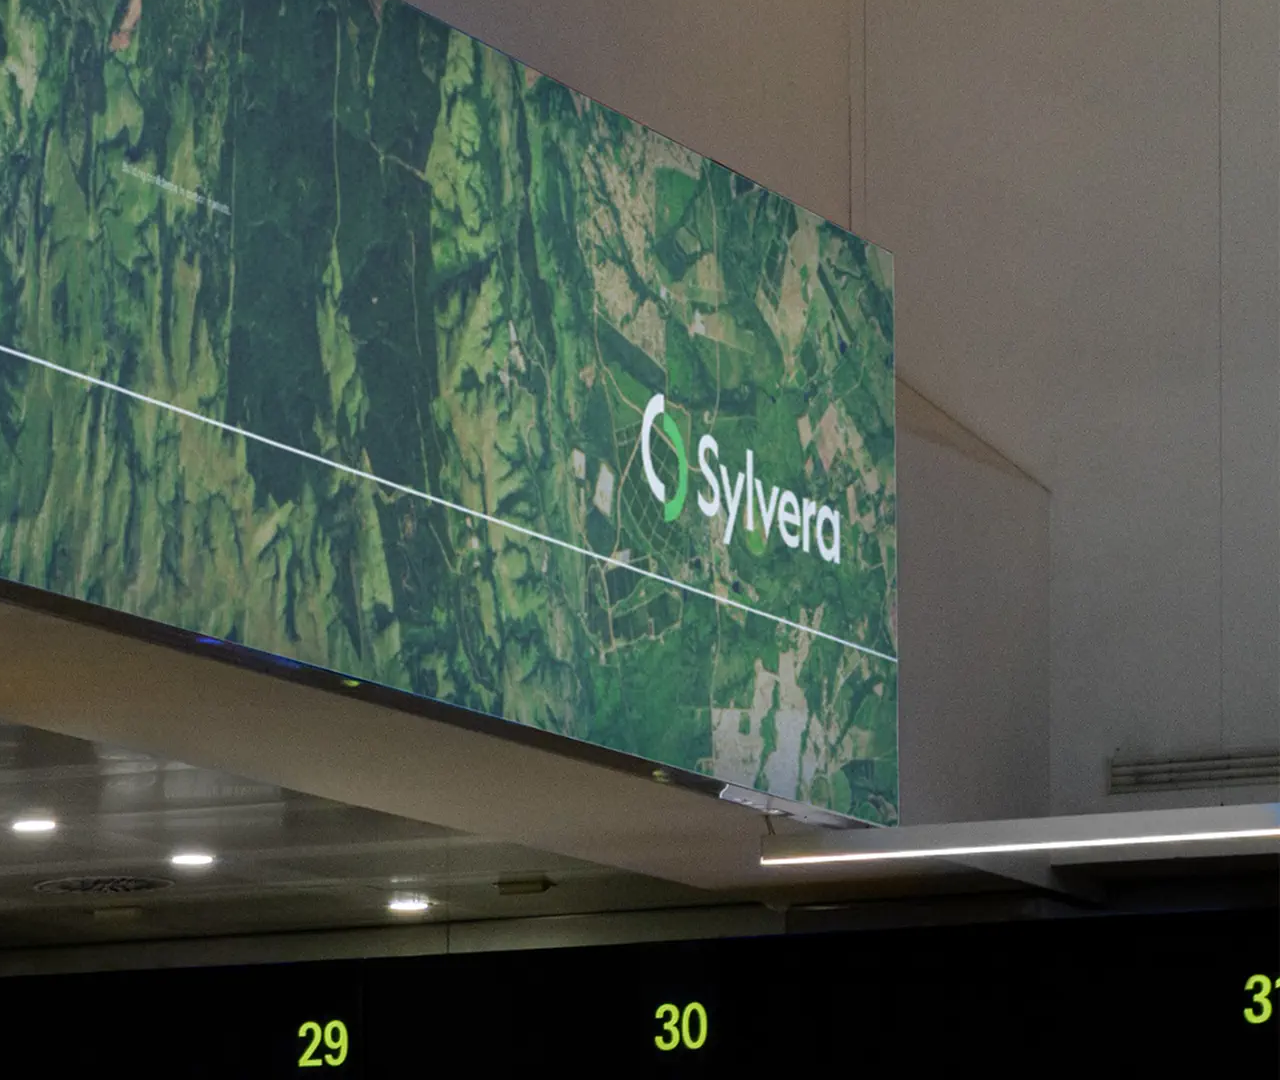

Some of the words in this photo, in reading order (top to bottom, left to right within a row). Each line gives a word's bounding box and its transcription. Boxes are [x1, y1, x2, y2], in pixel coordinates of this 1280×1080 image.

[697, 433, 841, 565] Sylvera
[1243, 973, 1280, 1024] 3
[298, 1019, 349, 1068] 29
[654, 1001, 708, 1051] 30
